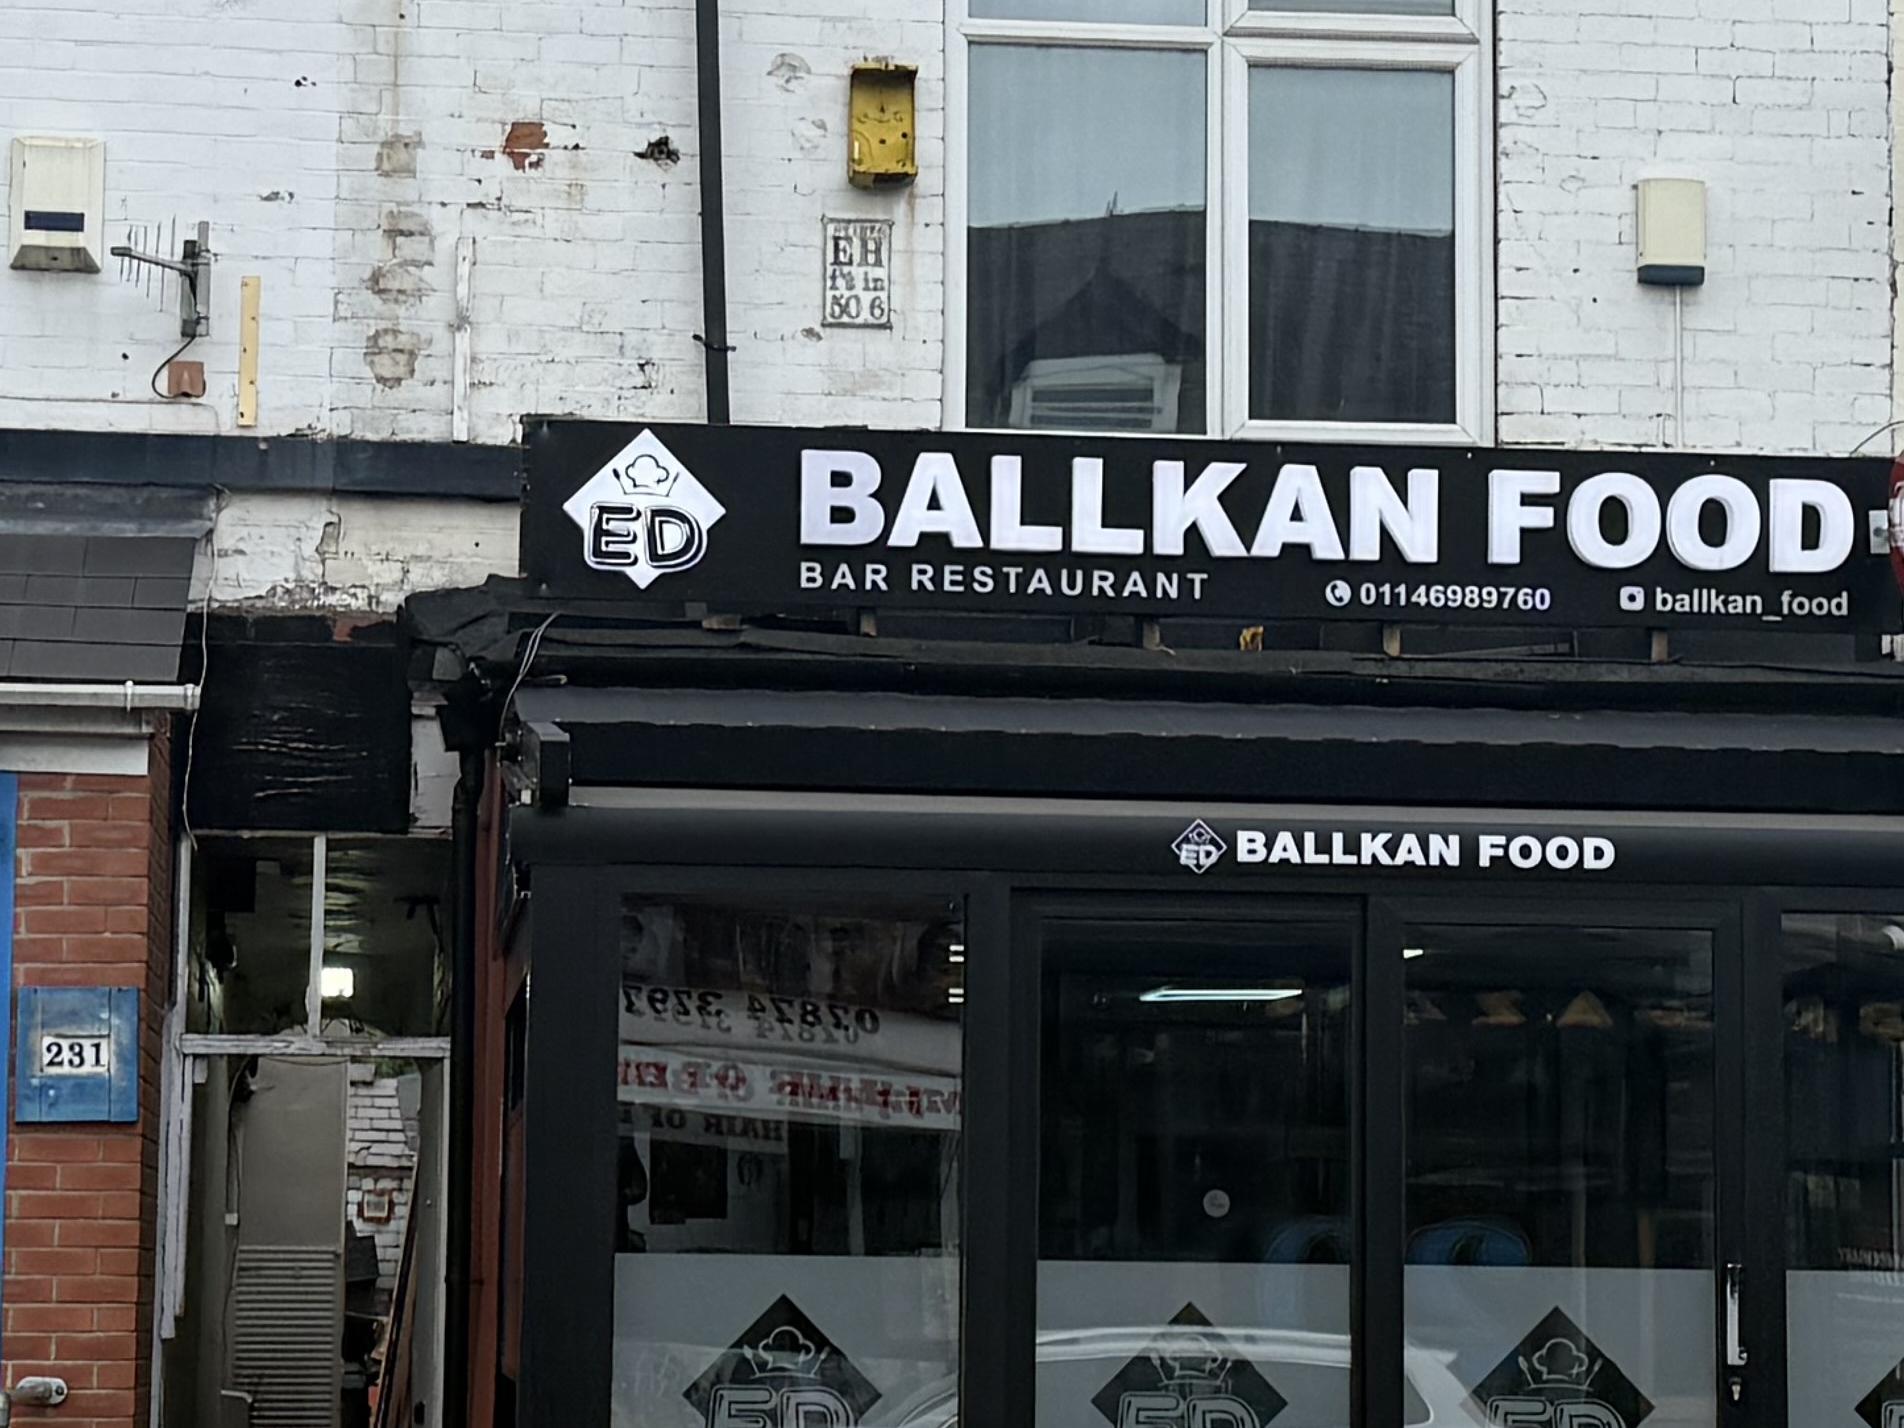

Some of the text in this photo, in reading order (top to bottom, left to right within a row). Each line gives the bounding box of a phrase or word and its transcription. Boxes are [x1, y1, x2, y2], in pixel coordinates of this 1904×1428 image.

[800, 448, 1854, 573] BALLKAN FOOD
[586, 502, 706, 572] ED
[800, 561, 1210, 600] BAR RESTAURANT
[1360, 580, 1551, 611] 01146989760
[1655, 585, 1849, 622] ballkan_food
[1237, 830, 1616, 871] BALLKAN FOOD
[45, 1041, 107, 1069] 231
